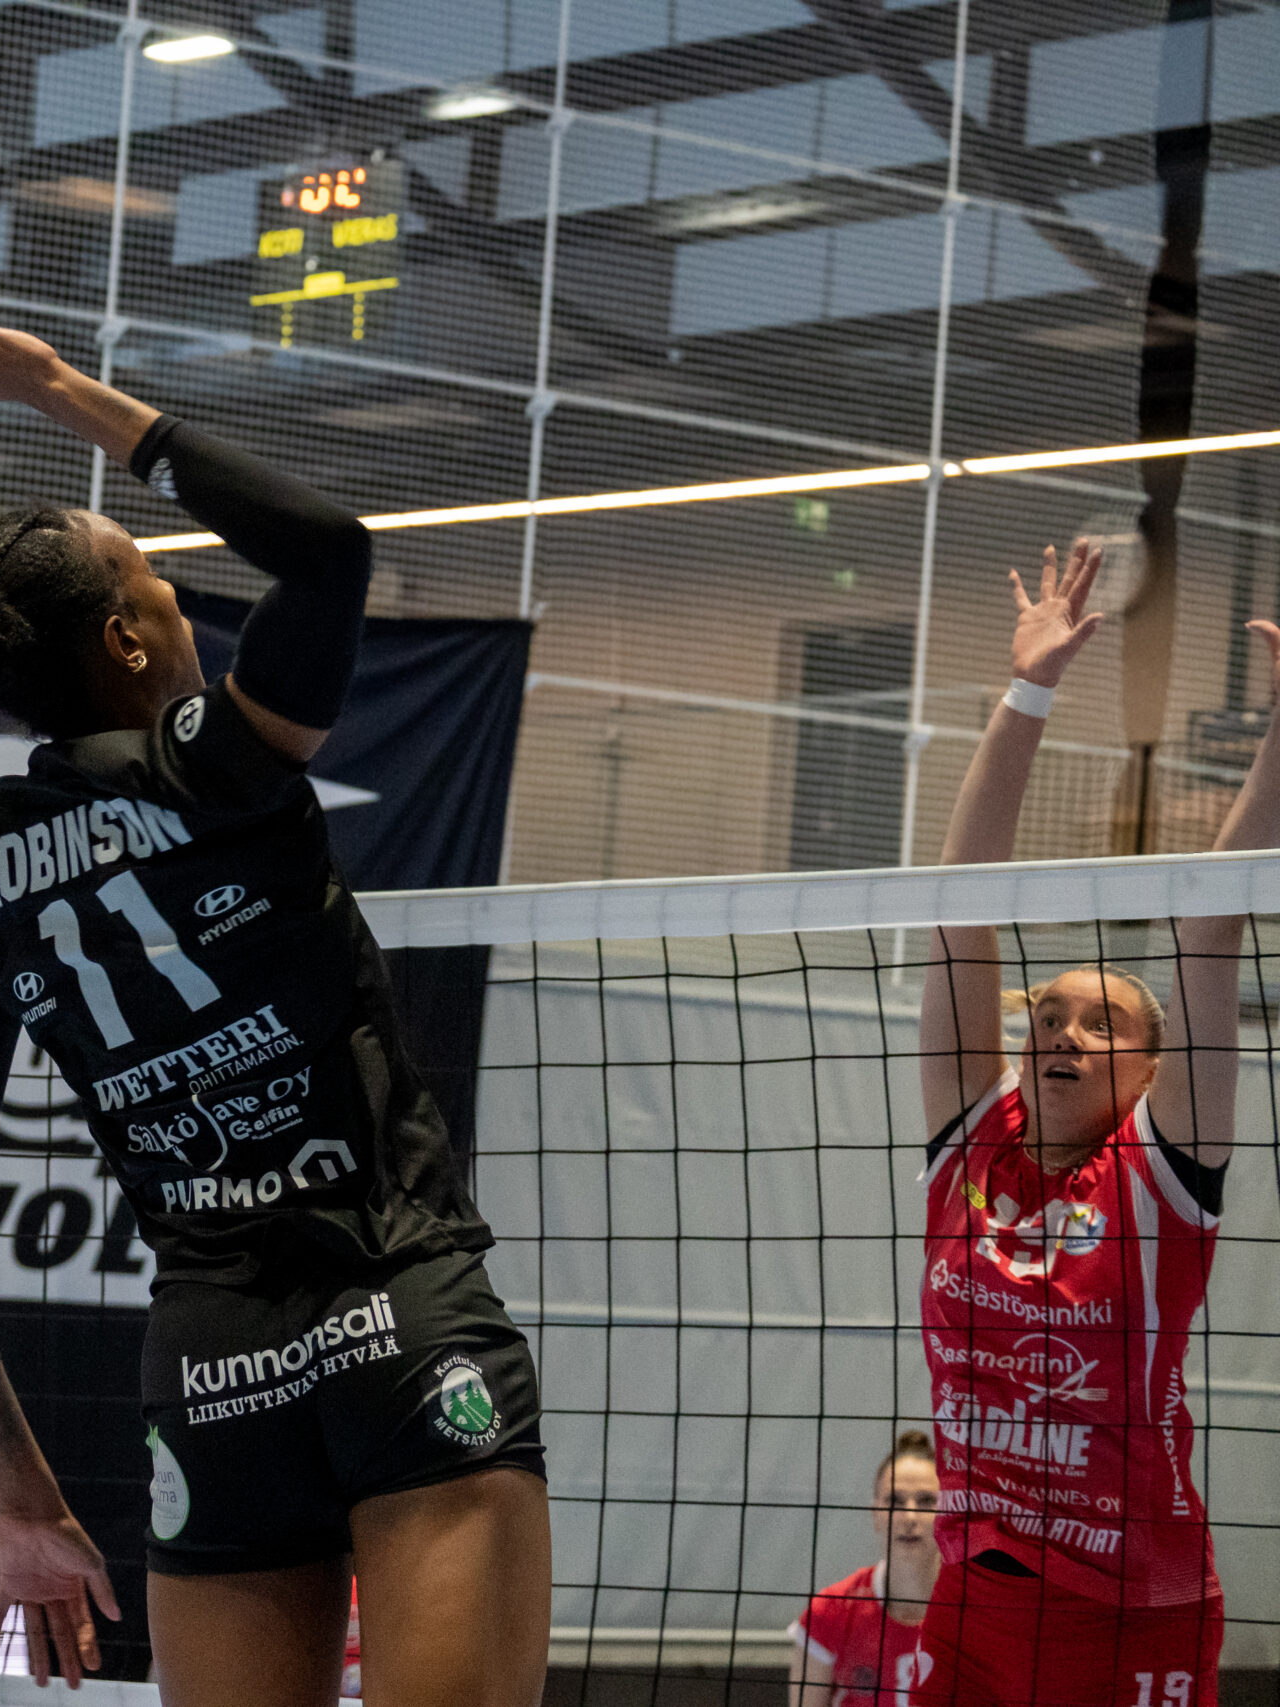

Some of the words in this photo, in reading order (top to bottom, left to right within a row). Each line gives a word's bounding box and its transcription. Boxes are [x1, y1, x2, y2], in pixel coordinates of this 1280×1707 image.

[197, 898, 272, 946] HYUNDAI
[37, 869, 222, 1050] 11
[21, 996, 57, 1026] YUNDAI
[92, 1004, 290, 1112] WETTERI
[188, 1033, 305, 1096] OHITTAMATON.
[161, 1171, 282, 1212] PURMO
[946, 1272, 1112, 1326] Säästöpankki
[181, 1292, 397, 1399] kunnonsali
[434, 1355, 483, 1378] Karttulan
[187, 1365, 320, 1425] LIIKUTTAVAN
[320, 1337, 402, 1377] HYVÄÄ
[433, 1416, 496, 1446] METSÄTYÖ
[492, 1410, 502, 1430] OY
